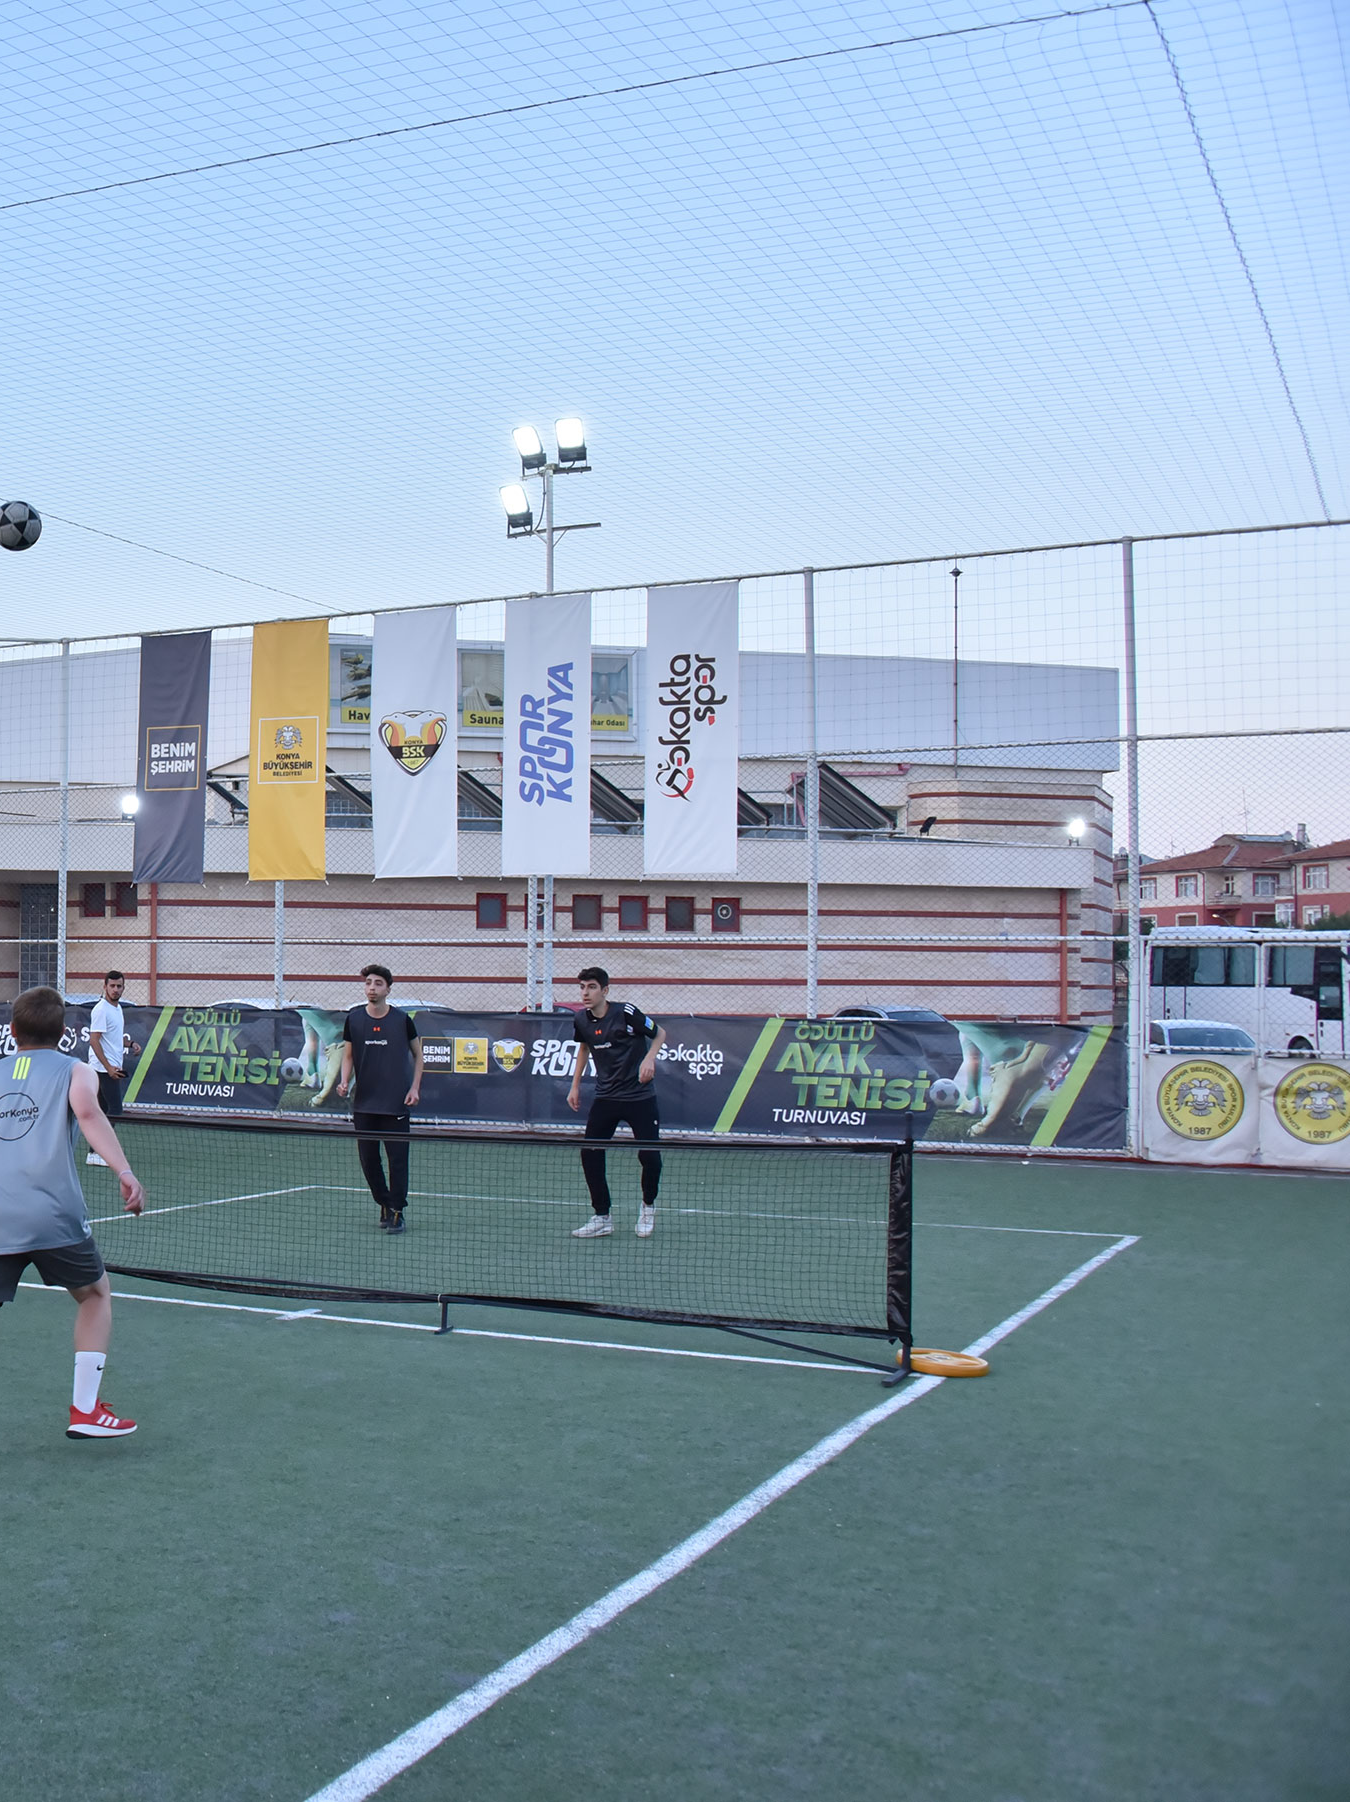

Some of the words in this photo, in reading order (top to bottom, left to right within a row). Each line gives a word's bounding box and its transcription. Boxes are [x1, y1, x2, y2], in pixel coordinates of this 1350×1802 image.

[694, 654, 728, 726] spor
[348, 709, 371, 721] Hav
[469, 713, 503, 725] Sauna
[537, 662, 574, 803] KONYA
[402, 746, 425, 757] BSK
[519, 694, 557, 807] SPOR
[183, 1008, 241, 1026] ÖDÜLLÜ
[795, 1020, 875, 1041] ÖDÜLLÜ
[167, 1026, 242, 1055] AYAK
[656, 1043, 723, 1063] Sokakta
[775, 1042, 877, 1075] AYAK
[180, 1049, 282, 1085] TENİSİ
[688, 1062, 723, 1081] spor
[165, 1082, 235, 1098] TURNUVASI
[792, 1069, 931, 1111] TENİSİ
[772, 1108, 866, 1126] TURNUVASI
[1188, 1126, 1212, 1136] 1987
[1307, 1130, 1332, 1139] 1987
